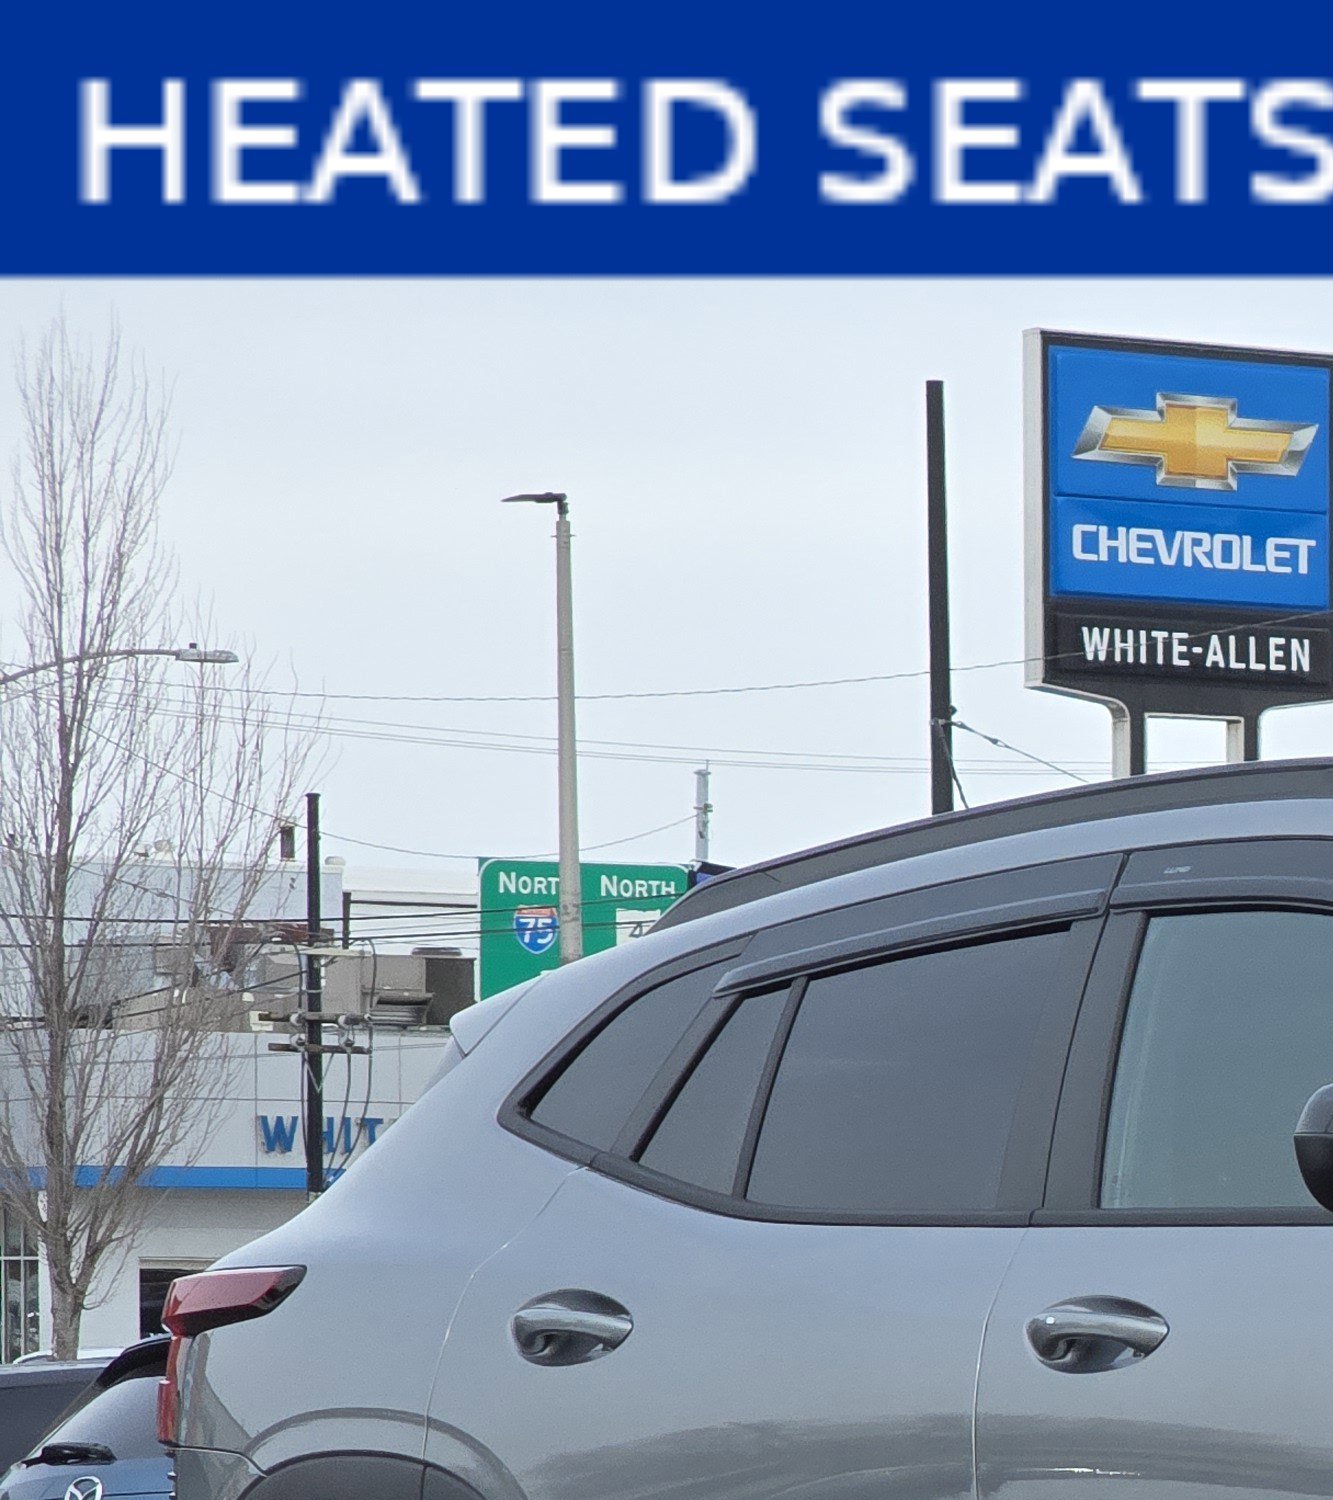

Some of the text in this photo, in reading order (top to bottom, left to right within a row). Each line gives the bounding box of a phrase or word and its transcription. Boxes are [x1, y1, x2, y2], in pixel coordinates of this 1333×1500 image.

[1072, 523, 1316, 574] CHEVROLET
[1081, 626, 1310, 672] WHITE-ALLEN
[498, 871, 560, 895] NORT
[600, 874, 676, 899] NORTH
[519, 918, 553, 944] 75
